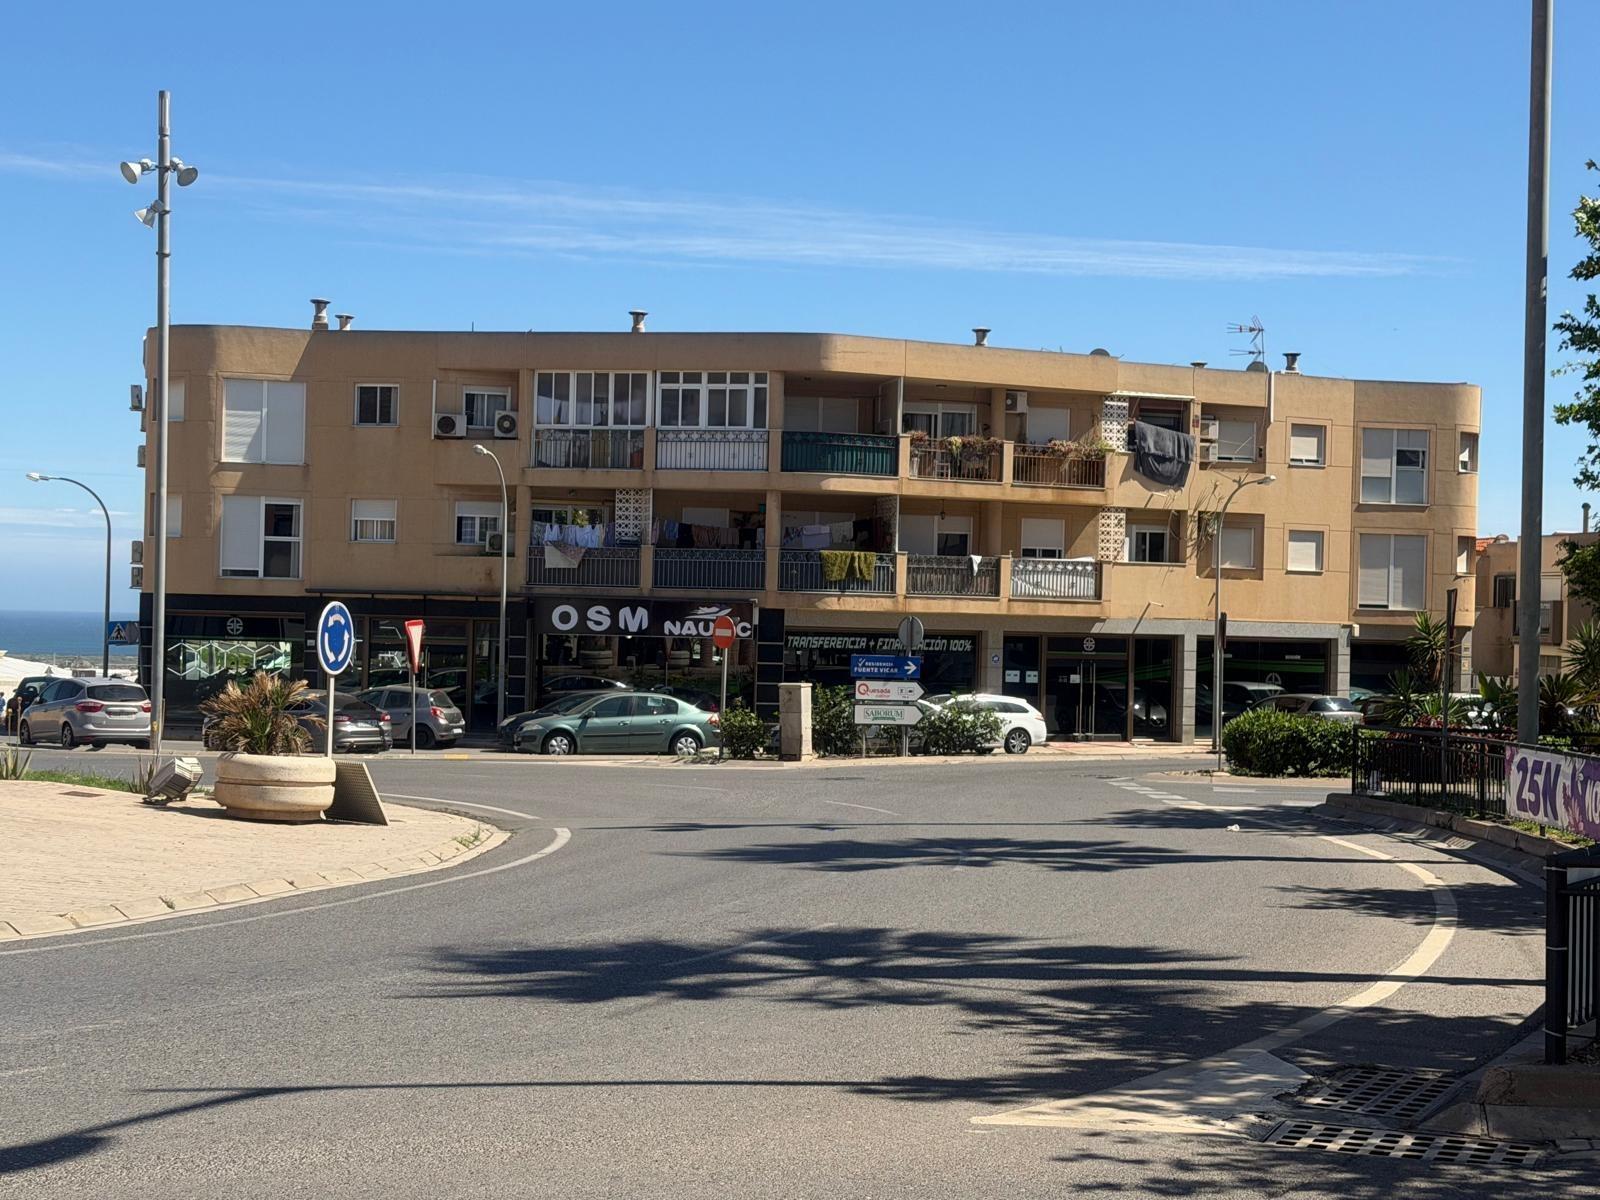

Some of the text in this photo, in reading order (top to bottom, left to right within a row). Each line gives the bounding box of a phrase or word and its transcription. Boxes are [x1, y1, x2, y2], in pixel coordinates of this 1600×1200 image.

[551, 604, 648, 632] OSM
[663, 620, 752, 638] NAUC
[787, 635, 867, 649] TRANSFERENCIA
[876, 636, 948, 651] FINAACIÓN
[949, 640, 972, 652] 100%
[1516, 757, 1562, 820] 25N
